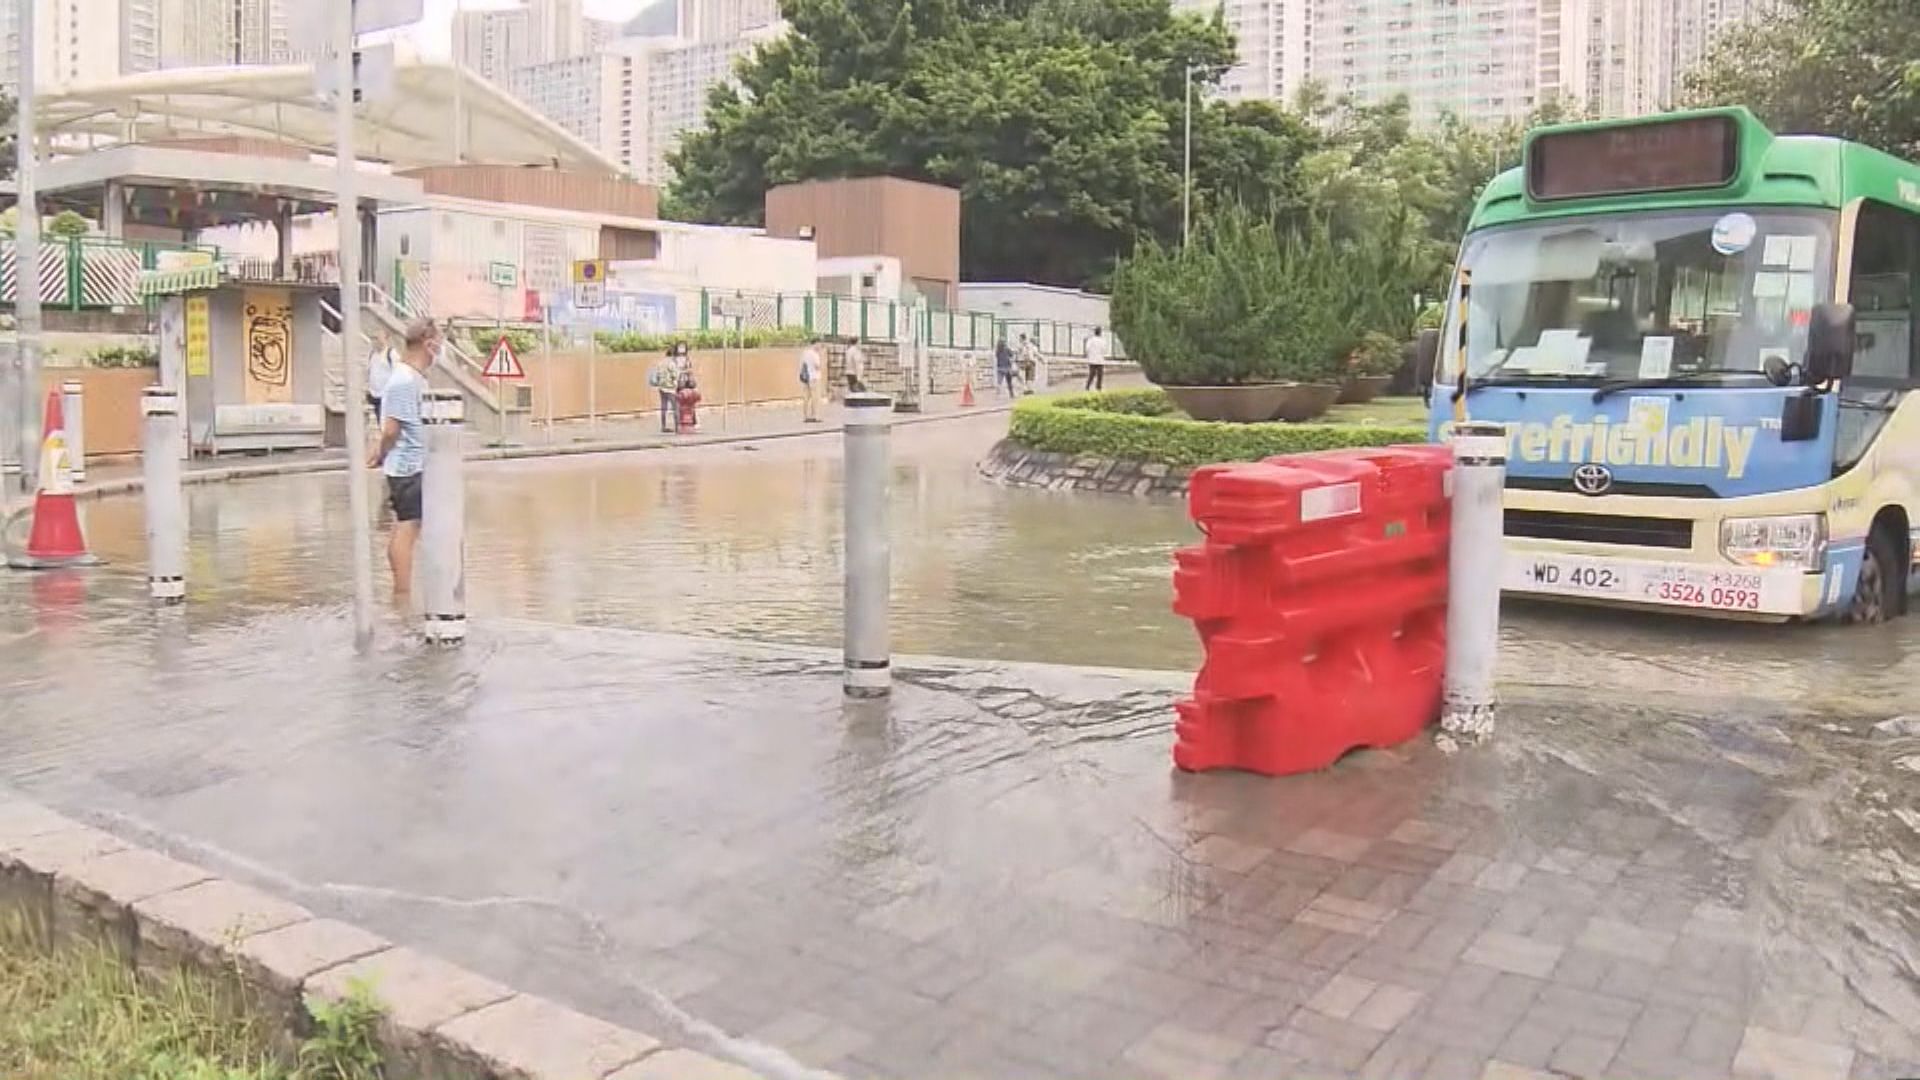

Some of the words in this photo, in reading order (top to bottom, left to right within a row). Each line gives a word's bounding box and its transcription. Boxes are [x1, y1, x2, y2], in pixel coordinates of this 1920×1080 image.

[1533, 563, 1560, 583] WD
[1570, 567, 1613, 588] 402
[1659, 582, 1704, 603] 3526
[1711, 588, 1759, 609] 0593
